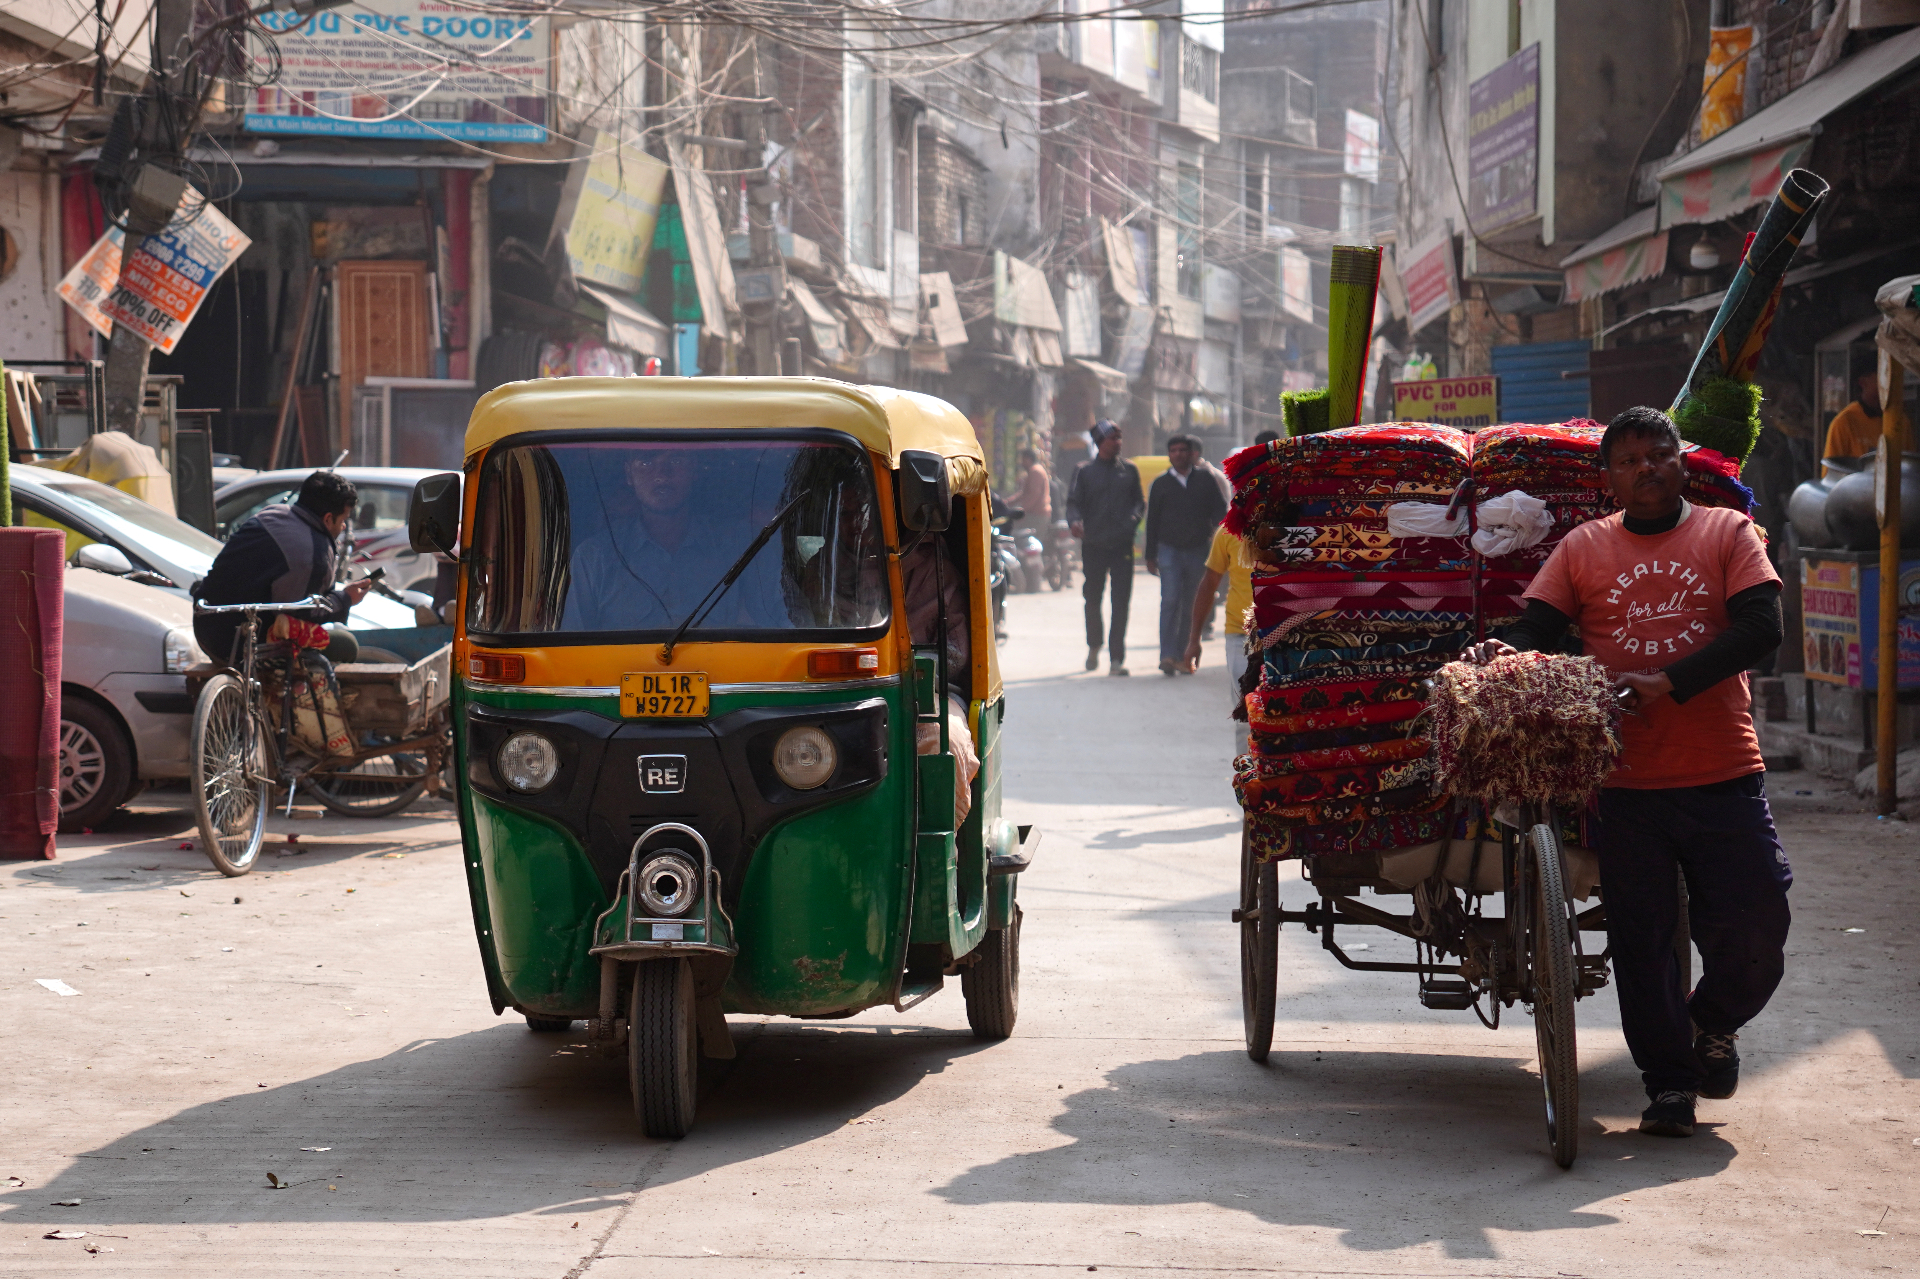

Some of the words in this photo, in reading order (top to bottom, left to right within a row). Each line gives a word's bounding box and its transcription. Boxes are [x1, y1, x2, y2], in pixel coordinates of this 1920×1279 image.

[354, 14, 410, 36] PVC
[422, 16, 533, 40] DOORS
[302, 120, 333, 132] Market
[360, 122, 380, 134] Near
[465, 126, 486, 137] New
[162, 267, 202, 298] TEST
[109, 284, 150, 318] 70%
[146, 307, 176, 334] OFF
[1397, 385, 1434, 402] PVC
[1442, 382, 1493, 399] DOOR
[1434, 402, 1457, 412] FOR
[1607, 561, 1709, 604] HEALTHY
[1626, 601, 1653, 628] for
[1657, 590, 1687, 612] all
[1612, 620, 1705, 655] HABITS
[647, 768, 679, 785] RE
